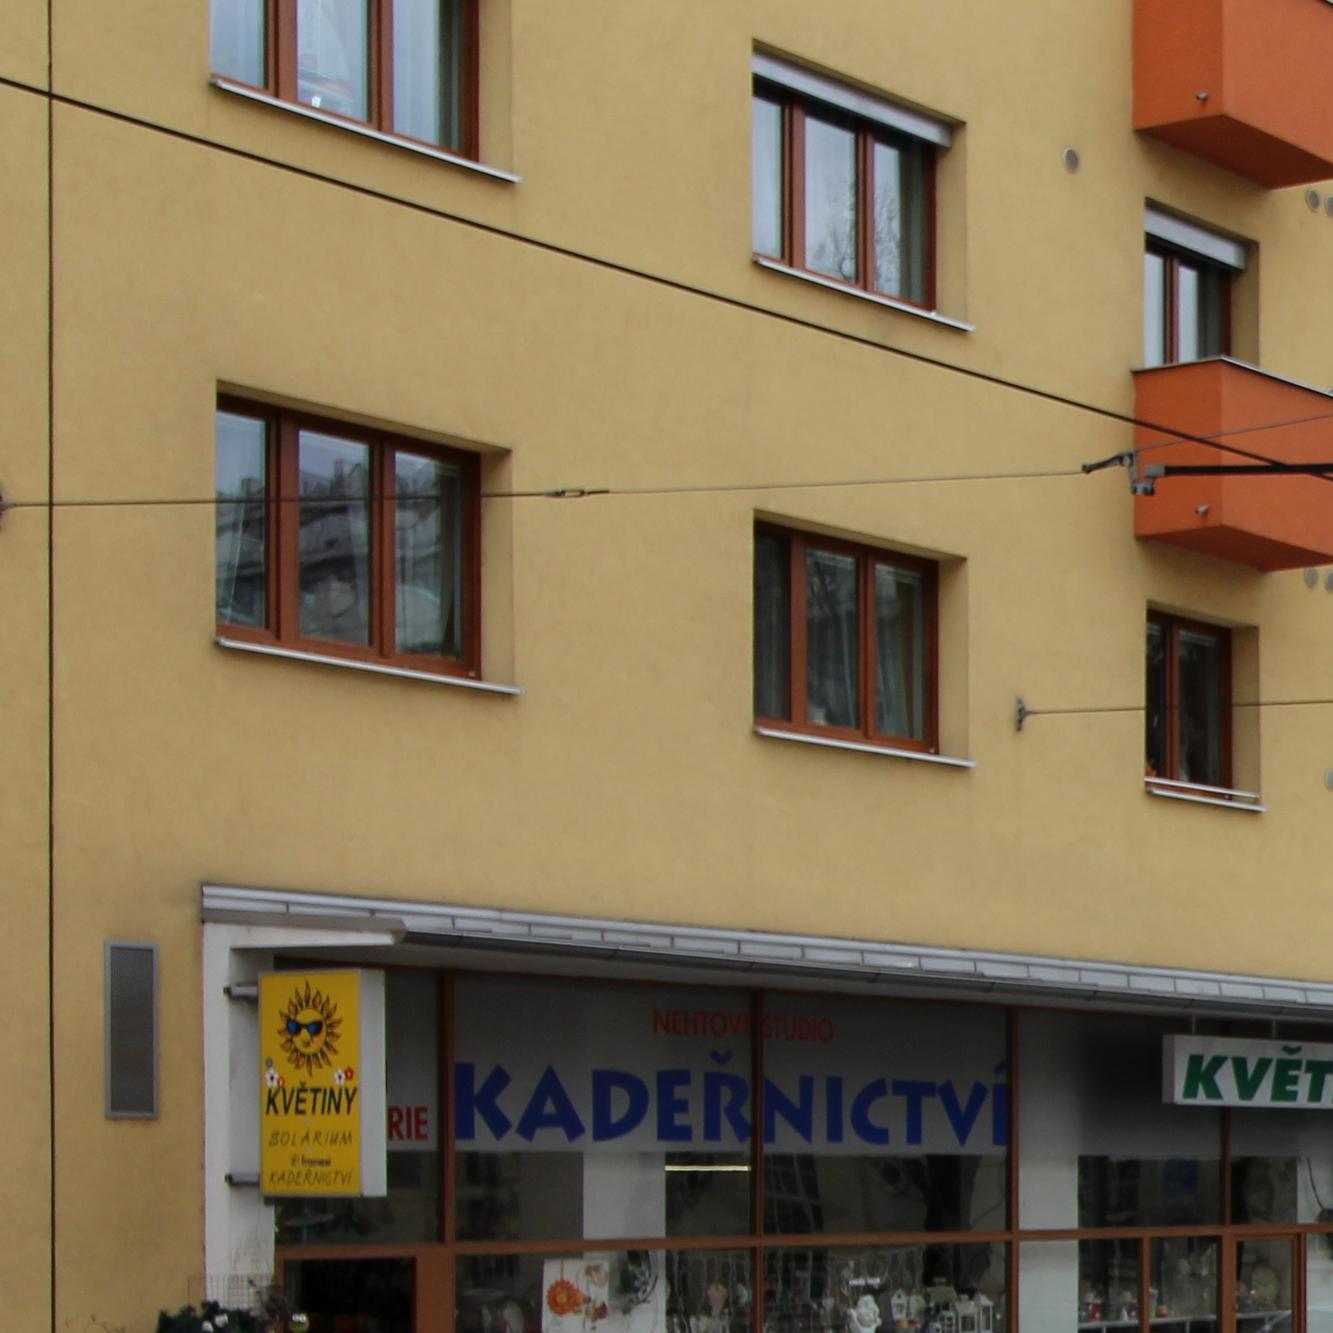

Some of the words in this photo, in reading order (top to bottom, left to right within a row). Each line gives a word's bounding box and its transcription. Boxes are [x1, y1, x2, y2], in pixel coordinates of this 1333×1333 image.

[266, 1082, 357, 1116] KVĚTINY
[455, 1050, 1009, 1146] KADEŘNICTVÍ
[387, 1106, 428, 1141] RIE
